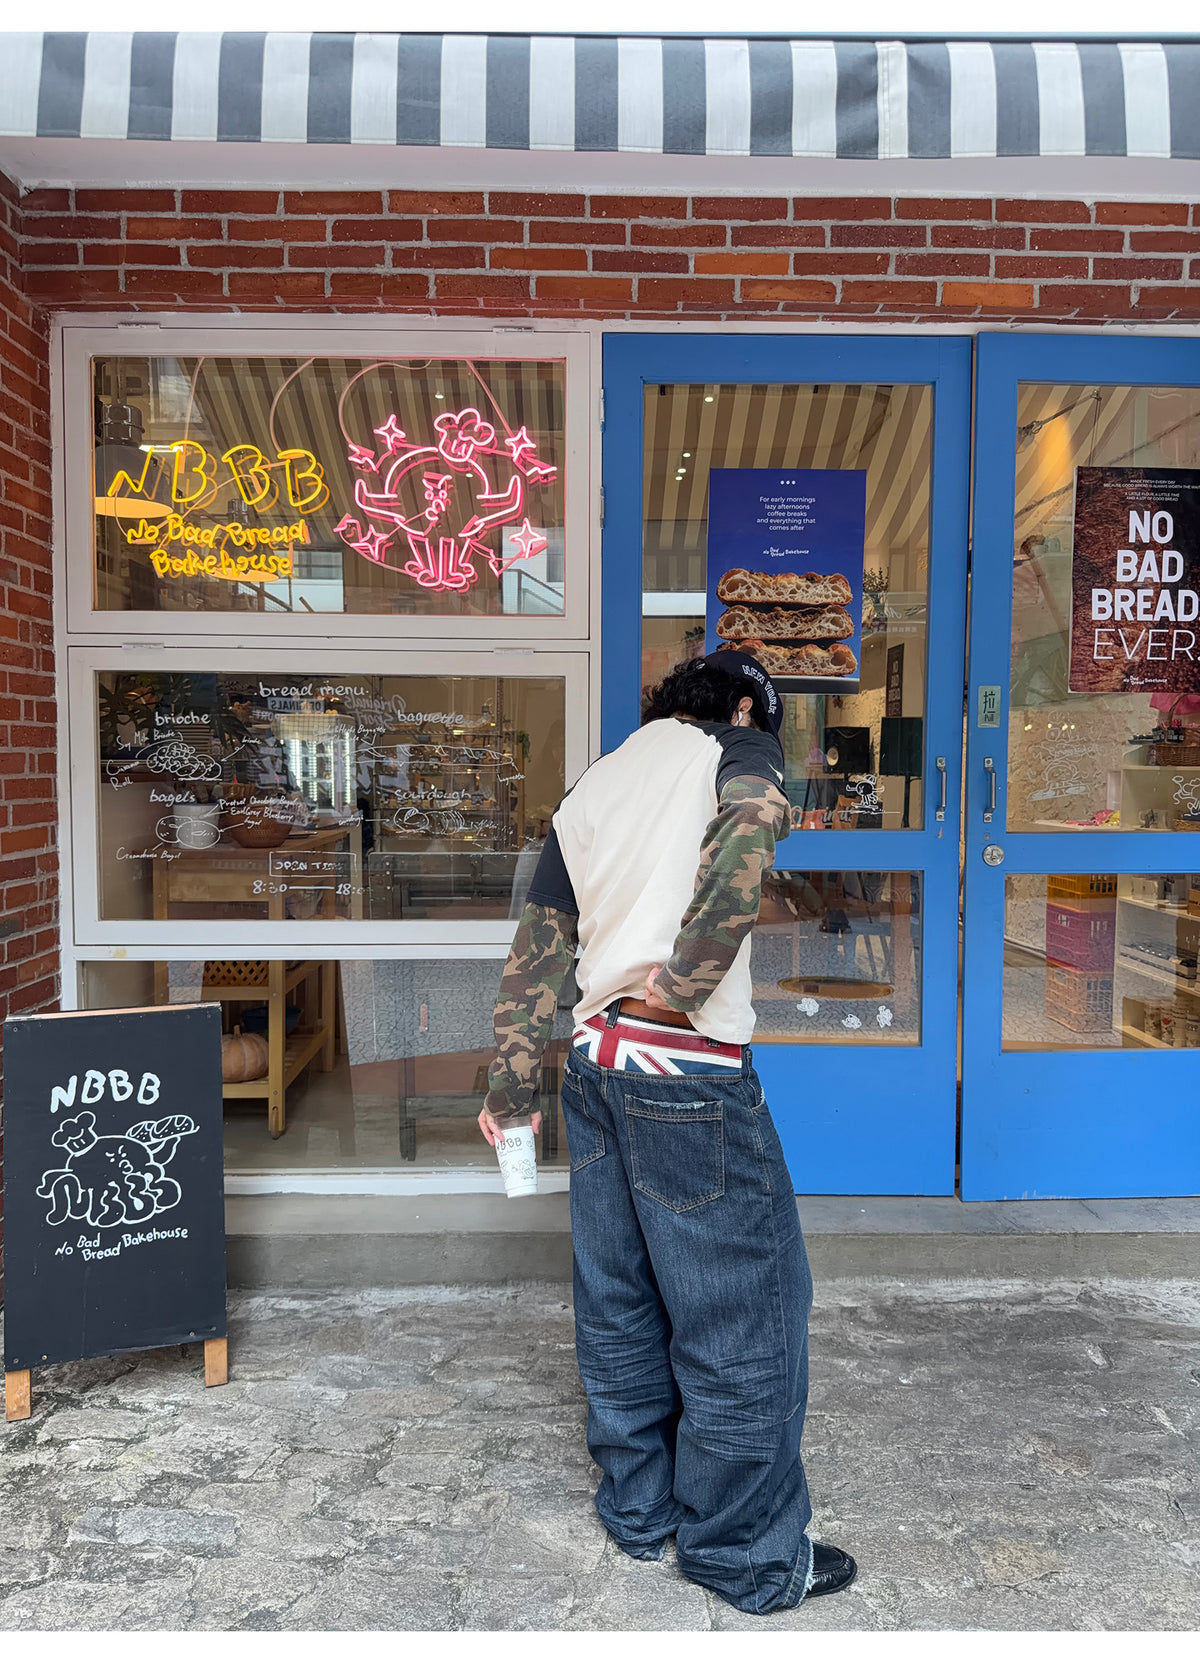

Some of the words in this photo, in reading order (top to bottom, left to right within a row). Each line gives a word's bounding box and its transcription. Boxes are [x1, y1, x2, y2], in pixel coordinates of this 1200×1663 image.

[108, 440, 326, 509] NBBB
[770, 496, 785, 504] early
[786, 496, 816, 504] mornings
[127, 519, 160, 544] No
[166, 513, 222, 549] Bad
[225, 519, 306, 547] Bread
[1128, 510, 1174, 544] NO
[150, 548, 292, 578] Bakehouse
[1116, 549, 1184, 583] BAD
[983, 690, 996, 714] 拉
[155, 711, 211, 726] brioche
[397, 709, 465, 726] baguette
[149, 789, 196, 807] bagels
[50, 1068, 161, 1114] NBBB
[77, 1232, 101, 1248] Bad
[121, 1227, 189, 1248] Bakehouse
[55, 1241, 74, 1256] No
[82, 1242, 122, 1261] Bread
